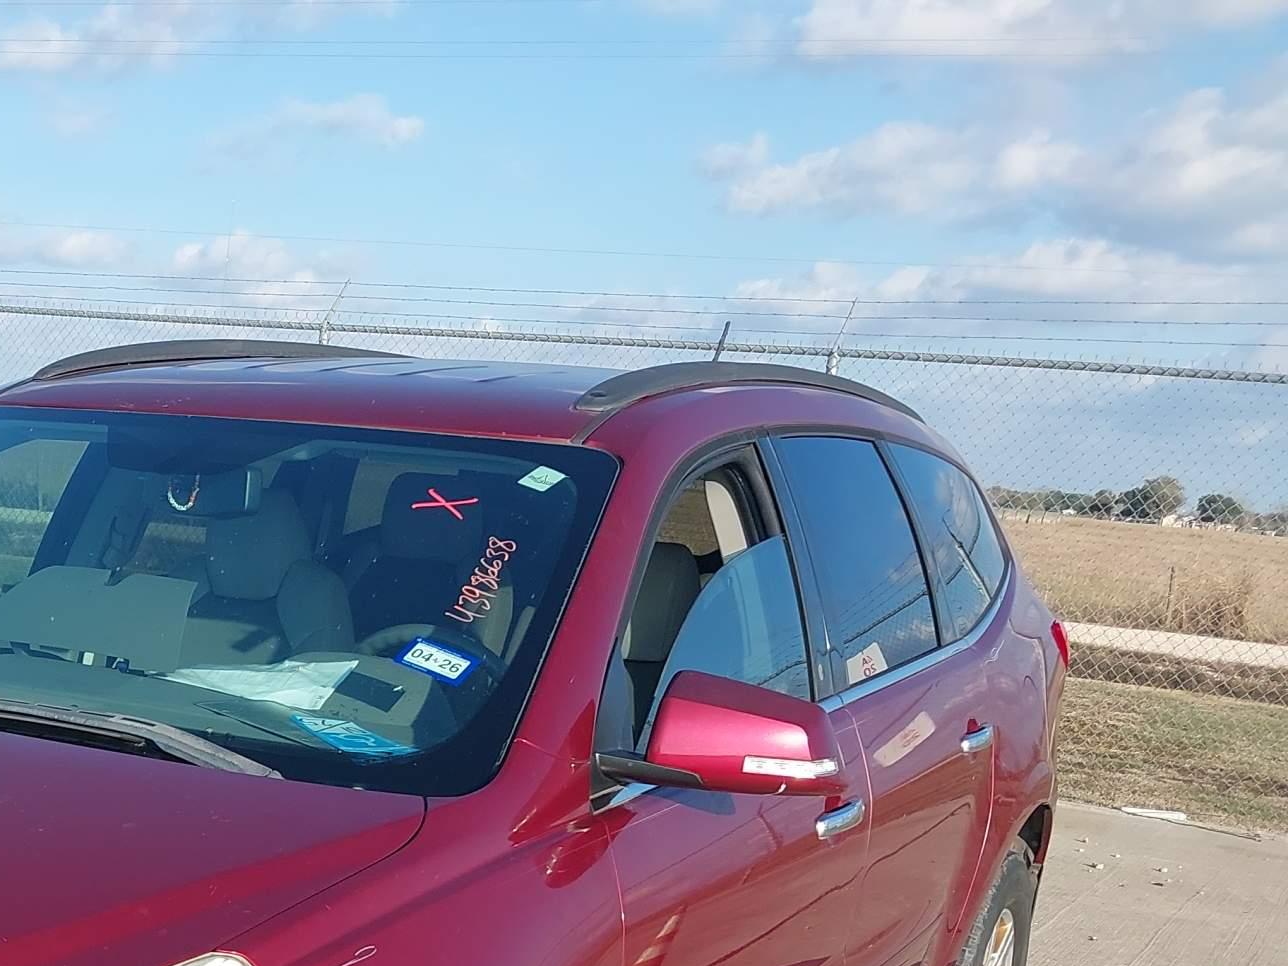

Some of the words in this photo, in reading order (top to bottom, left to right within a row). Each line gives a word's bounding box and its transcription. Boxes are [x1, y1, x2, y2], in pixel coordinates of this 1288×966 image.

[444, 535, 517, 623] 43986638
[410, 647, 434, 663] 04
[438, 658, 463, 674] 26
